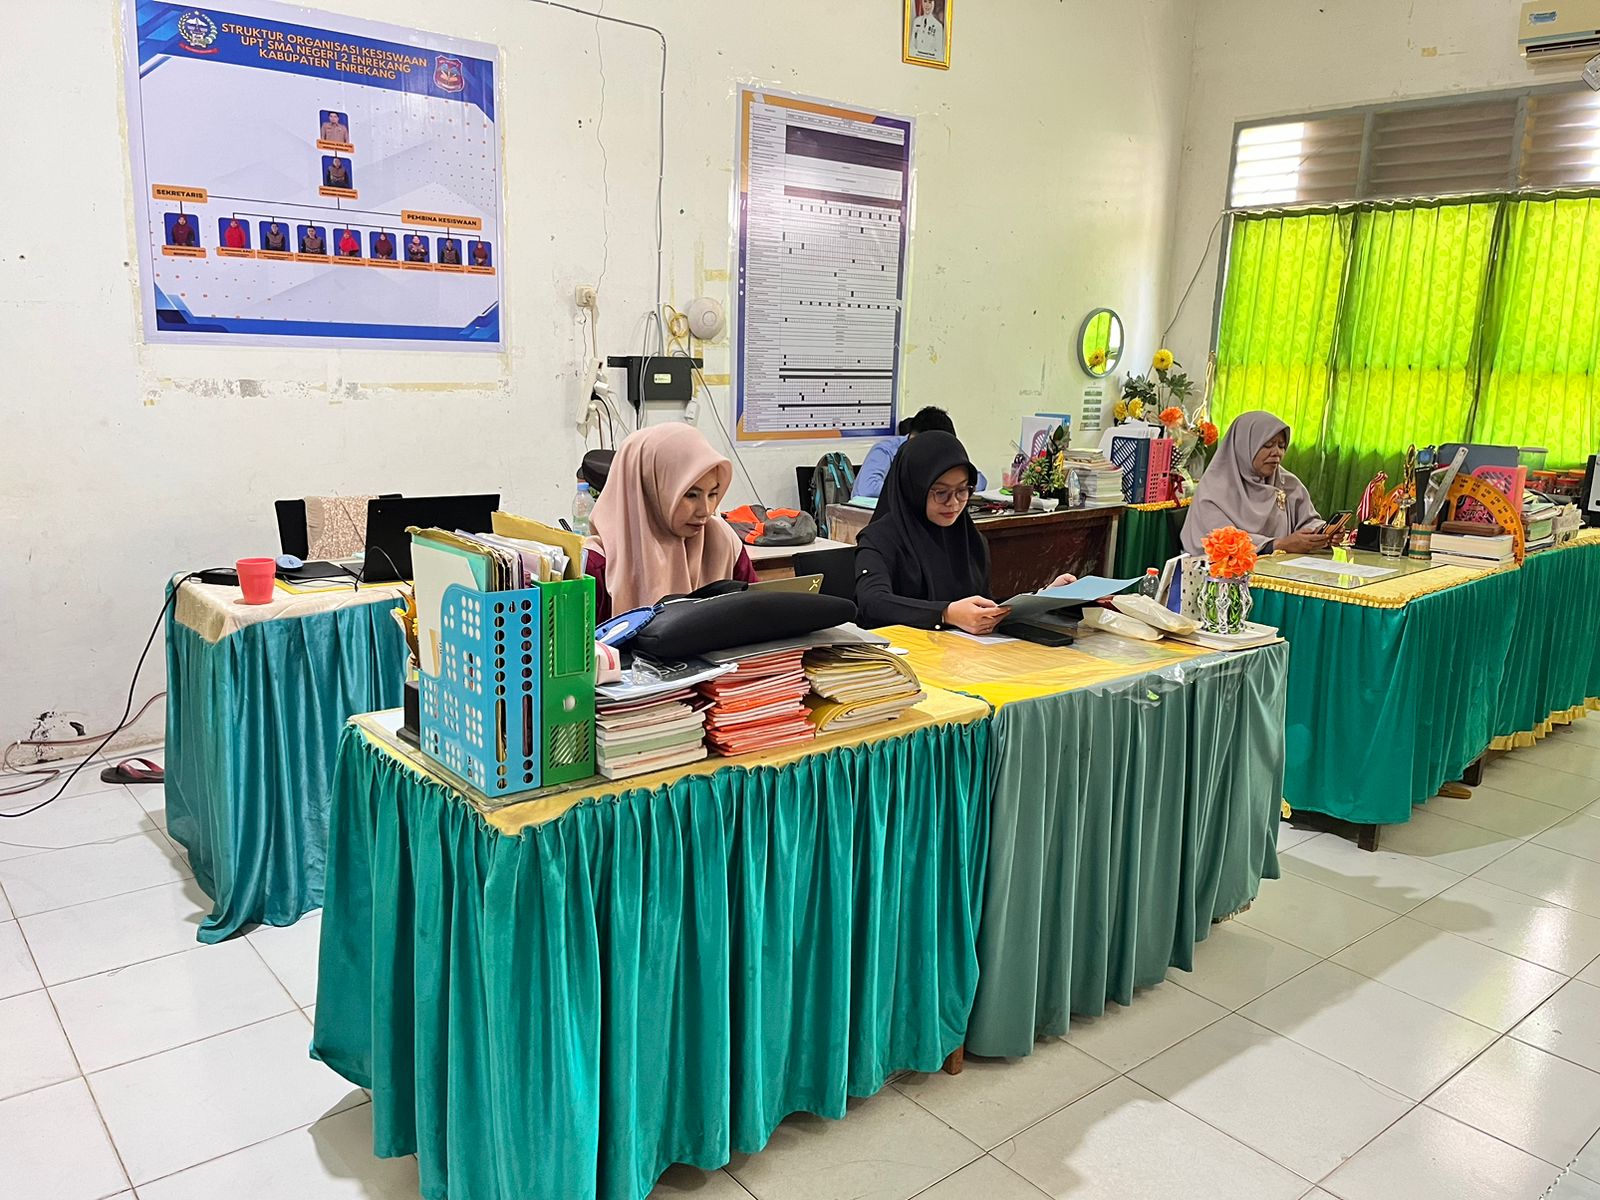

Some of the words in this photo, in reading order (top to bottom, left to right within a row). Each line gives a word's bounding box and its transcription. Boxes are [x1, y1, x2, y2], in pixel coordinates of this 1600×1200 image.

[221, 23, 285, 42] STRUKTUR
[287, 34, 360, 55] ORGANISASI
[361, 47, 428, 67] KESISWAAN
[240, 36, 264, 48] UPT
[267, 40, 294, 53] SMA
[296, 45, 338, 60] NEGERI
[340, 53, 349, 62] 2
[351, 55, 412, 73] ENREKANG
[259, 48, 330, 69] KABUPATEN
[335, 61, 397, 80] ENREKANG
[156, 189, 204, 199] SEKRETARIS
[406, 213, 438, 223] PEMBINA
[438, 216, 477, 226] KESISWAAN
